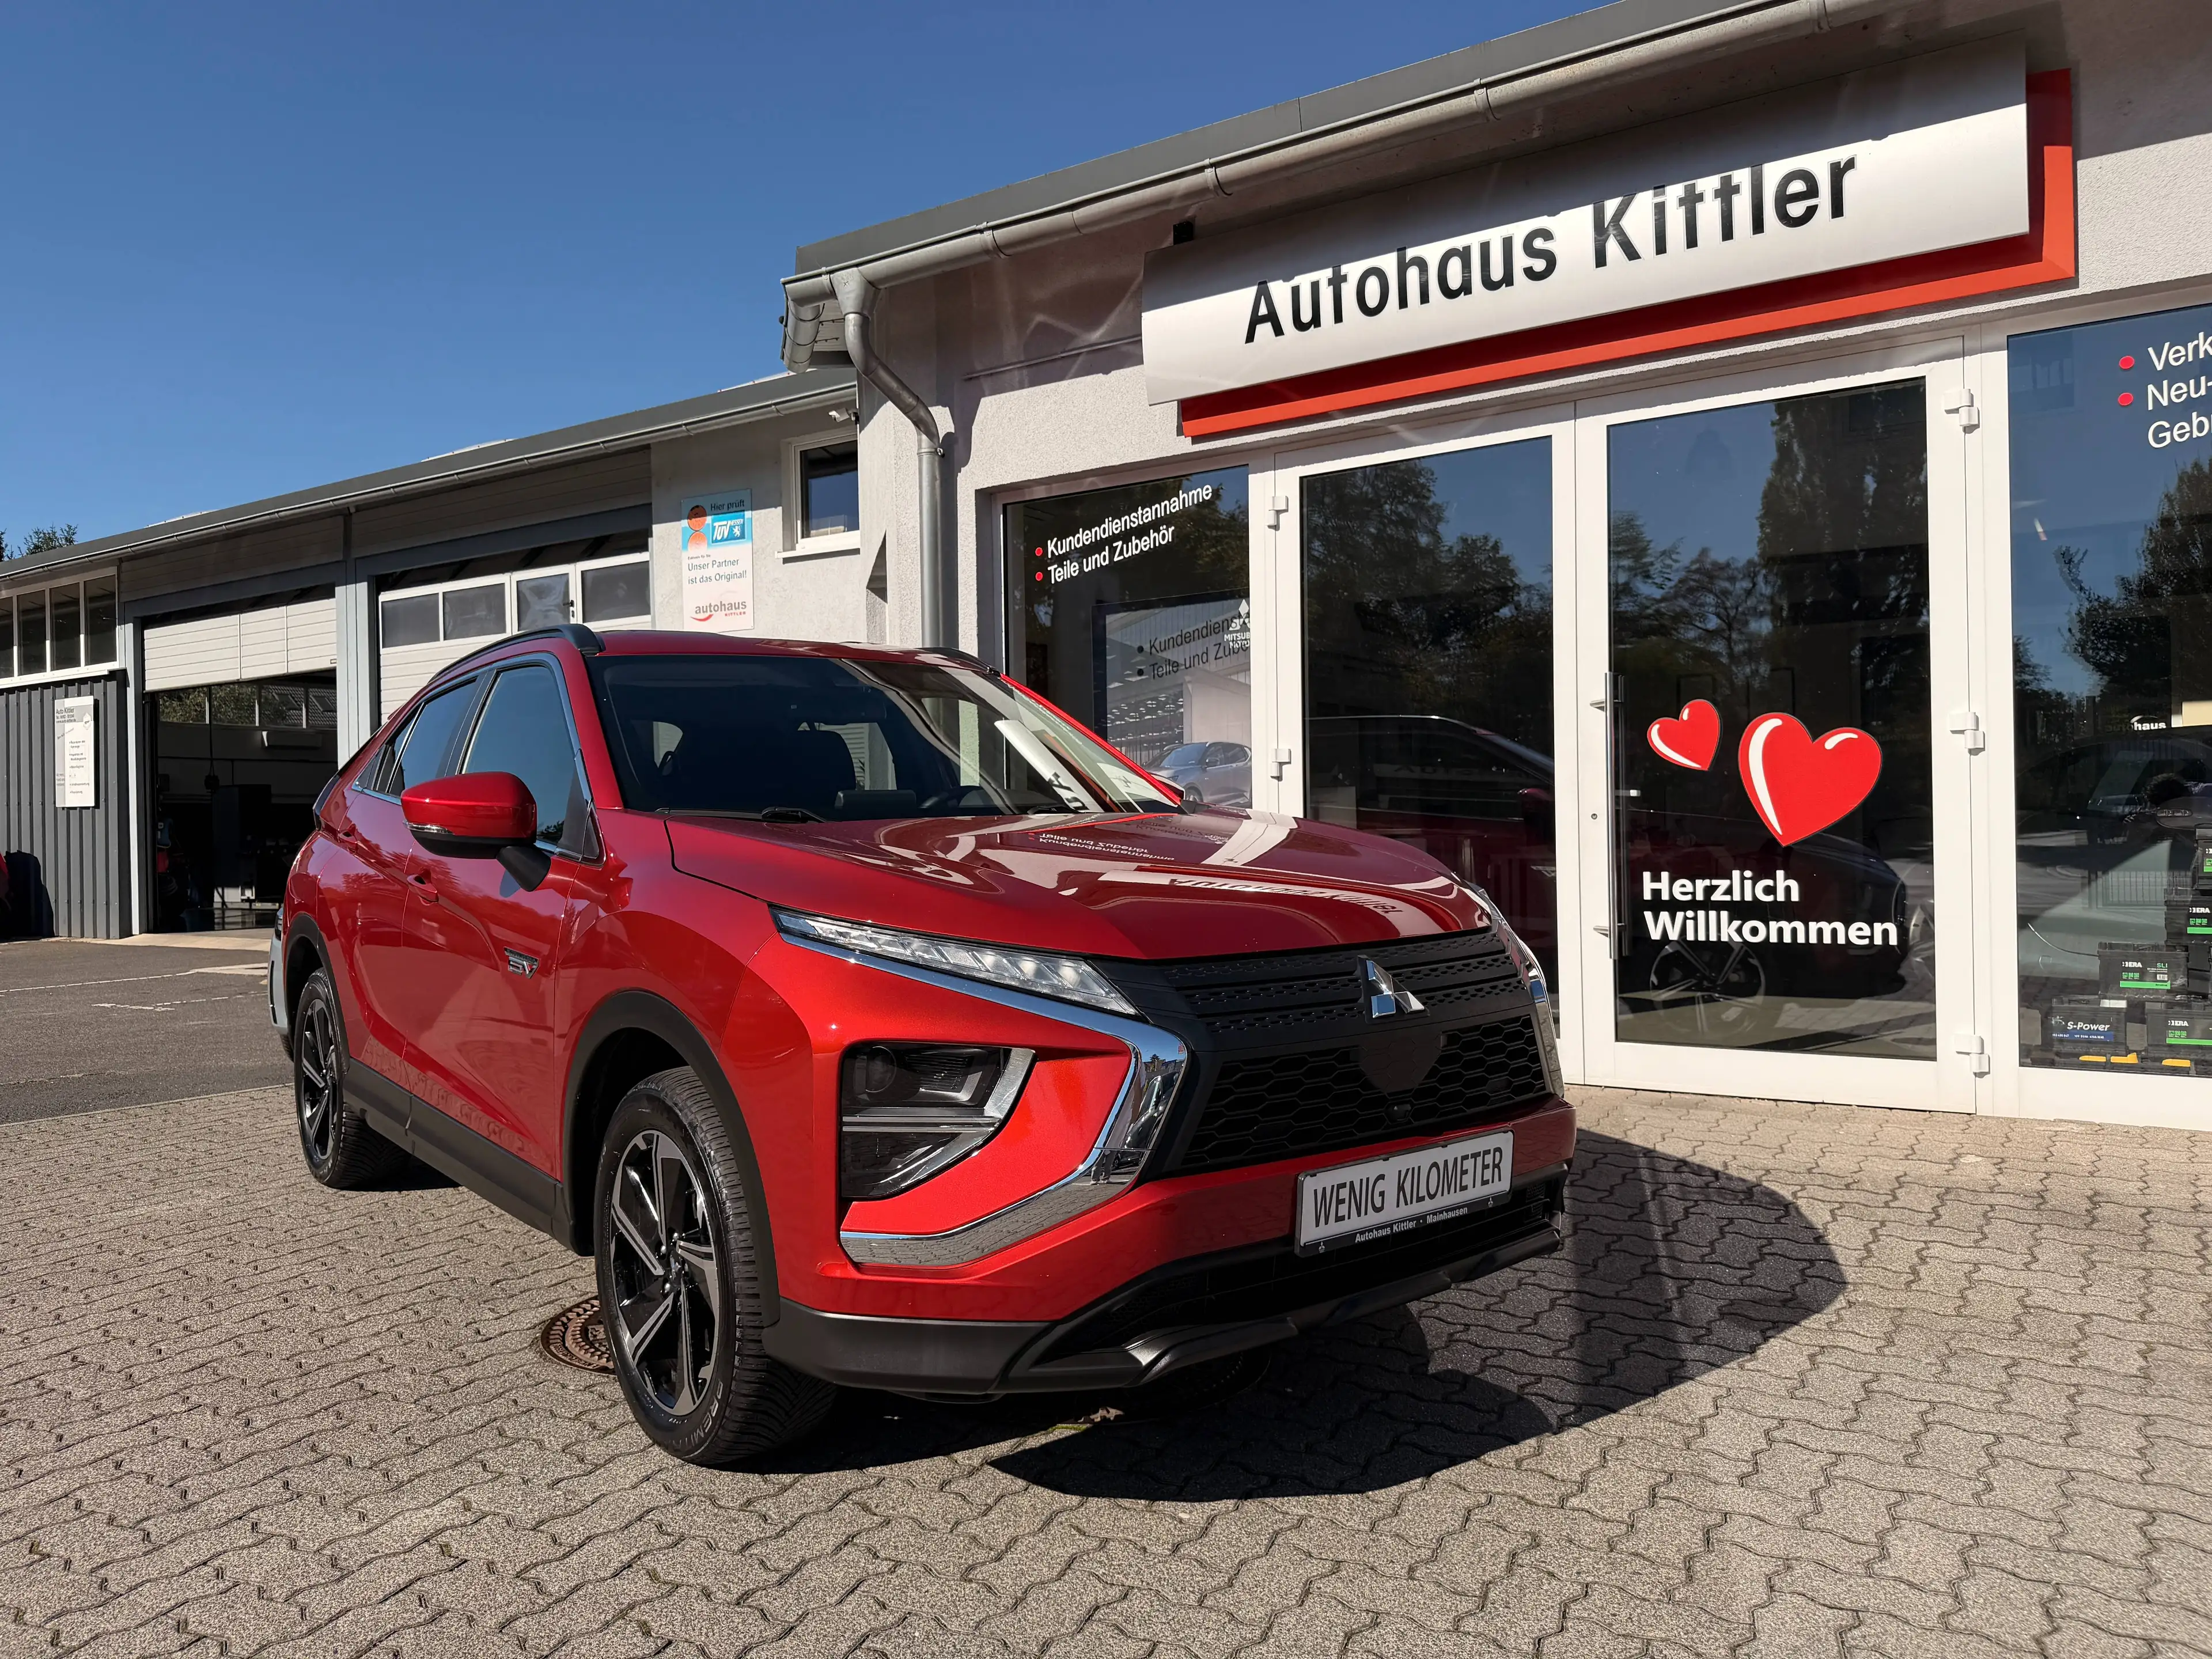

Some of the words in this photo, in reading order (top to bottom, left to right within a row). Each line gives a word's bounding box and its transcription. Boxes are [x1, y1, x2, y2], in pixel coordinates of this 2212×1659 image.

[1244, 226, 1557, 344] Autohaus
[1593, 154, 1857, 269] Kittler
[2147, 411, 2212, 448] Geb
[710, 503, 726, 512] Hier
[728, 499, 745, 510] prüft
[1047, 484, 1212, 558] Kundendienstannahme
[688, 562, 710, 571] Unser
[712, 559, 740, 569] Partner
[1048, 560, 1080, 584] Teile
[1083, 549, 1109, 573] und
[1113, 525, 1175, 562] Zubehör
[688, 576, 697, 585] ist
[699, 574, 713, 584] das
[714, 569, 747, 582] Original!
[695, 600, 747, 614] autohaus
[1149, 659, 1179, 680] Teile
[1184, 647, 1209, 669] und
[1643, 869, 1800, 902] Herzlich
[1643, 909, 1897, 946] Willkommen
[2067, 1021, 2111, 1031] S-Power
[1313, 1173, 1385, 1228] WENIG
[1396, 1146, 1503, 1208] KILOMETER
[1355, 1227, 1391, 1243] Autohaus
[1393, 1219, 1417, 1233] Kittler
[1426, 1207, 1468, 1224] Mainhausen
